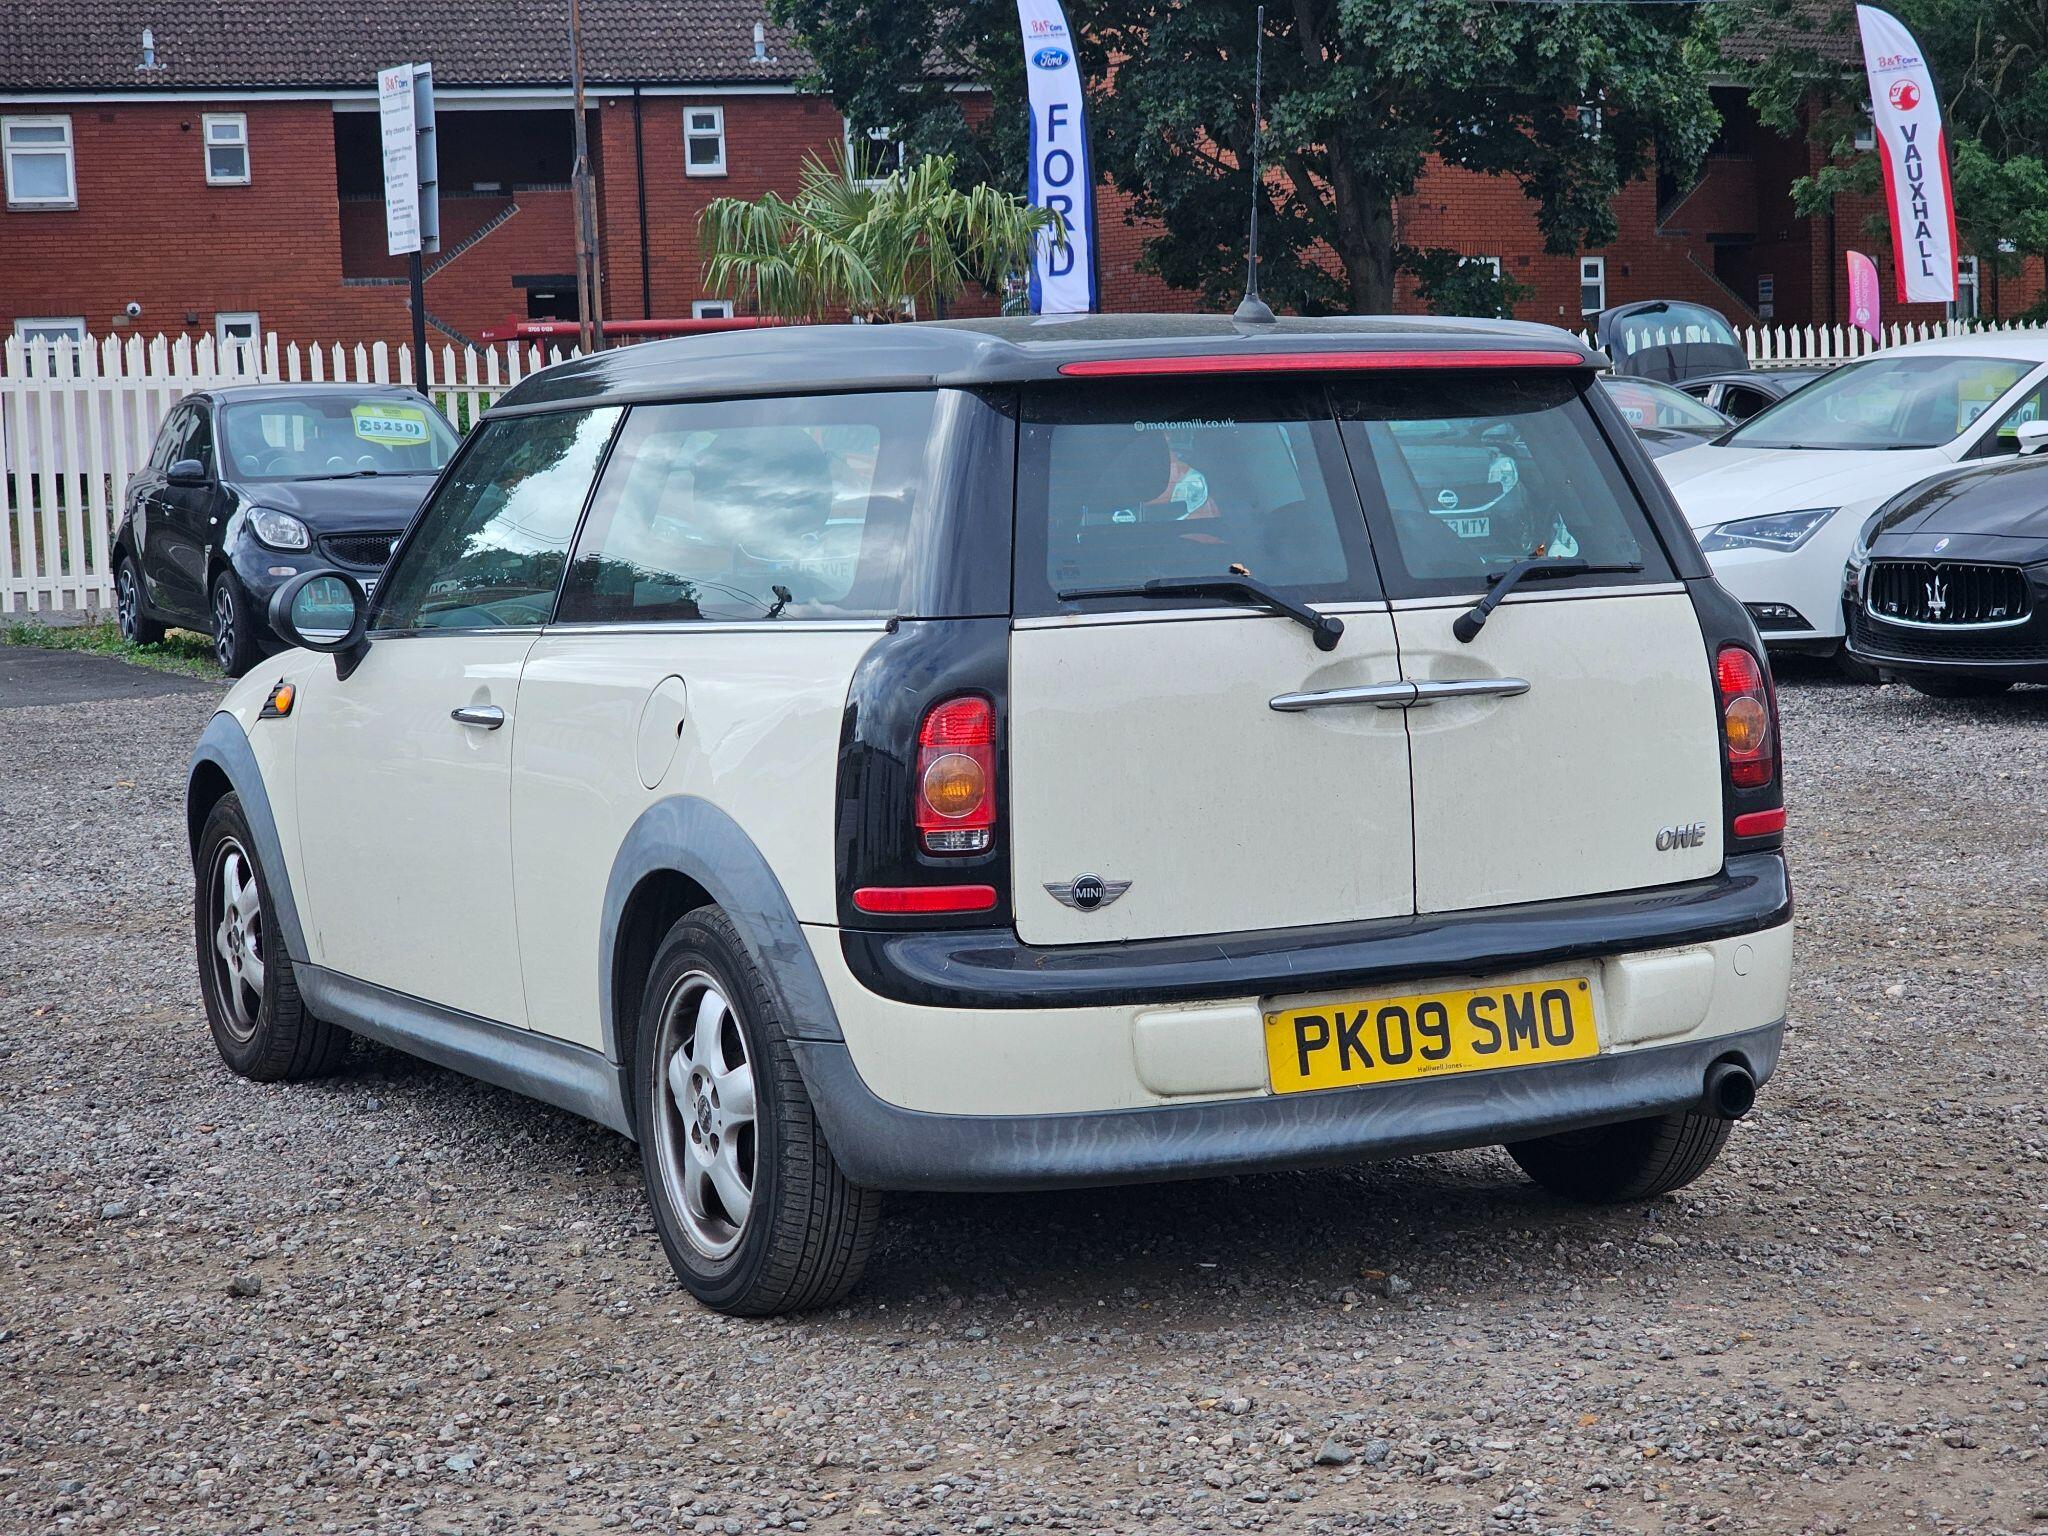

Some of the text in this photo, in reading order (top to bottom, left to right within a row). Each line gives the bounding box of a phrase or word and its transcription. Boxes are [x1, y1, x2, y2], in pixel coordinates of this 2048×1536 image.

[1041, 51, 1063, 67] Ford
[1044, 104, 1076, 277] FORD
[1900, 123, 1934, 277] VAUXHALL
[1145, 417, 1236, 430] motormill.co.uk
[1461, 519, 1487, 534] WTY
[1656, 821, 1706, 851] ONE
[1075, 887, 1102, 899] MINI
[1294, 988, 1575, 1077] PK09 SMO
[1417, 1063, 1443, 1073] Halliwell
[1445, 1062, 1463, 1070] Jones
